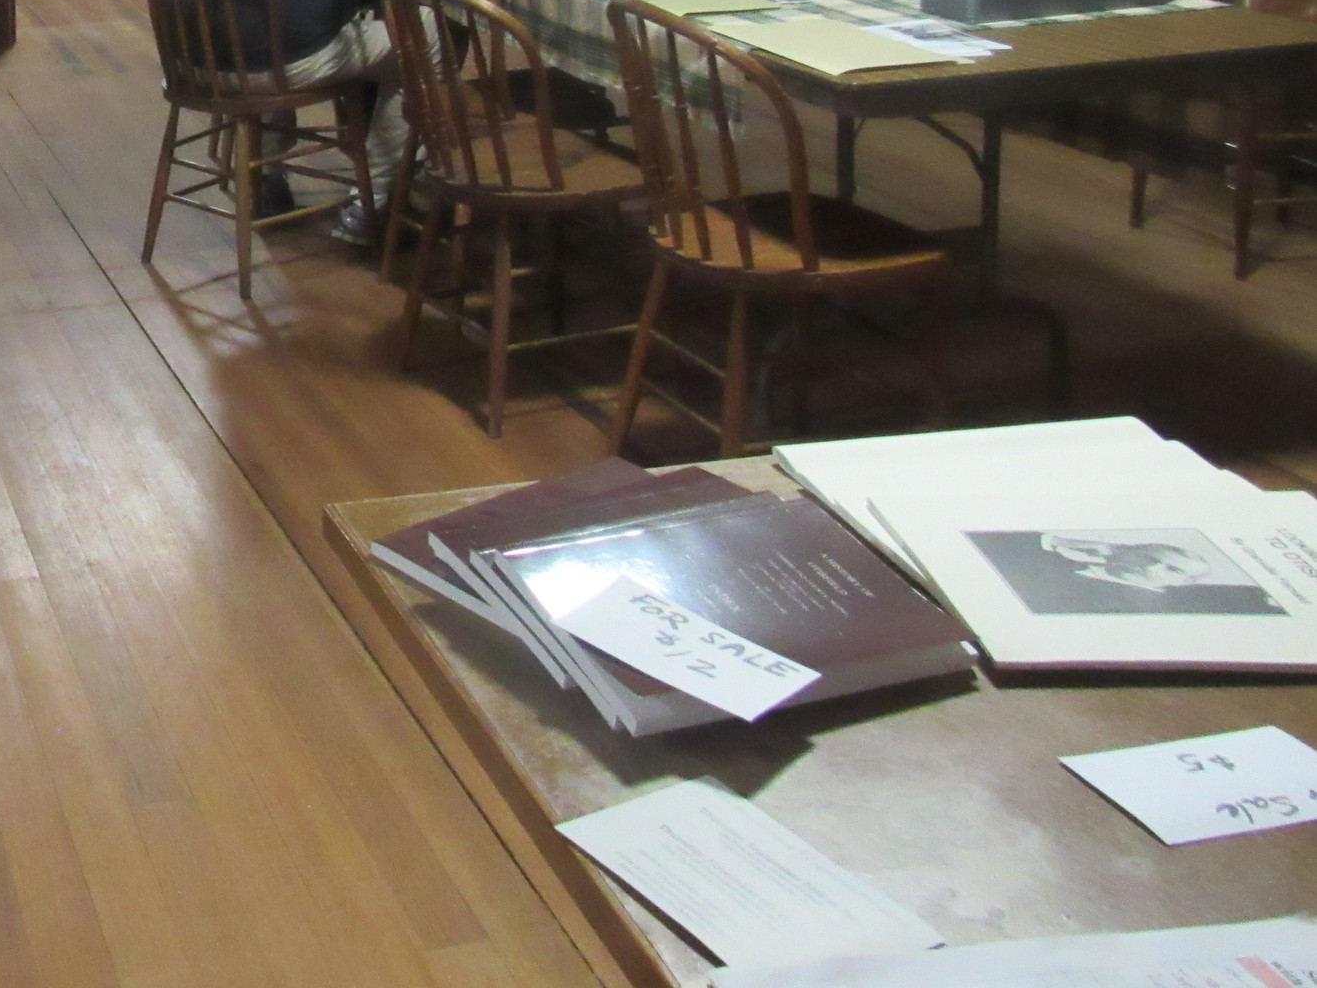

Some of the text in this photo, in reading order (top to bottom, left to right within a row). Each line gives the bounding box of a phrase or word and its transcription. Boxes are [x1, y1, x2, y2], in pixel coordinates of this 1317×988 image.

[630, 593, 689, 630] FOR
[700, 631, 801, 677] SALE
[1215, 795, 1299, 824] Sale
